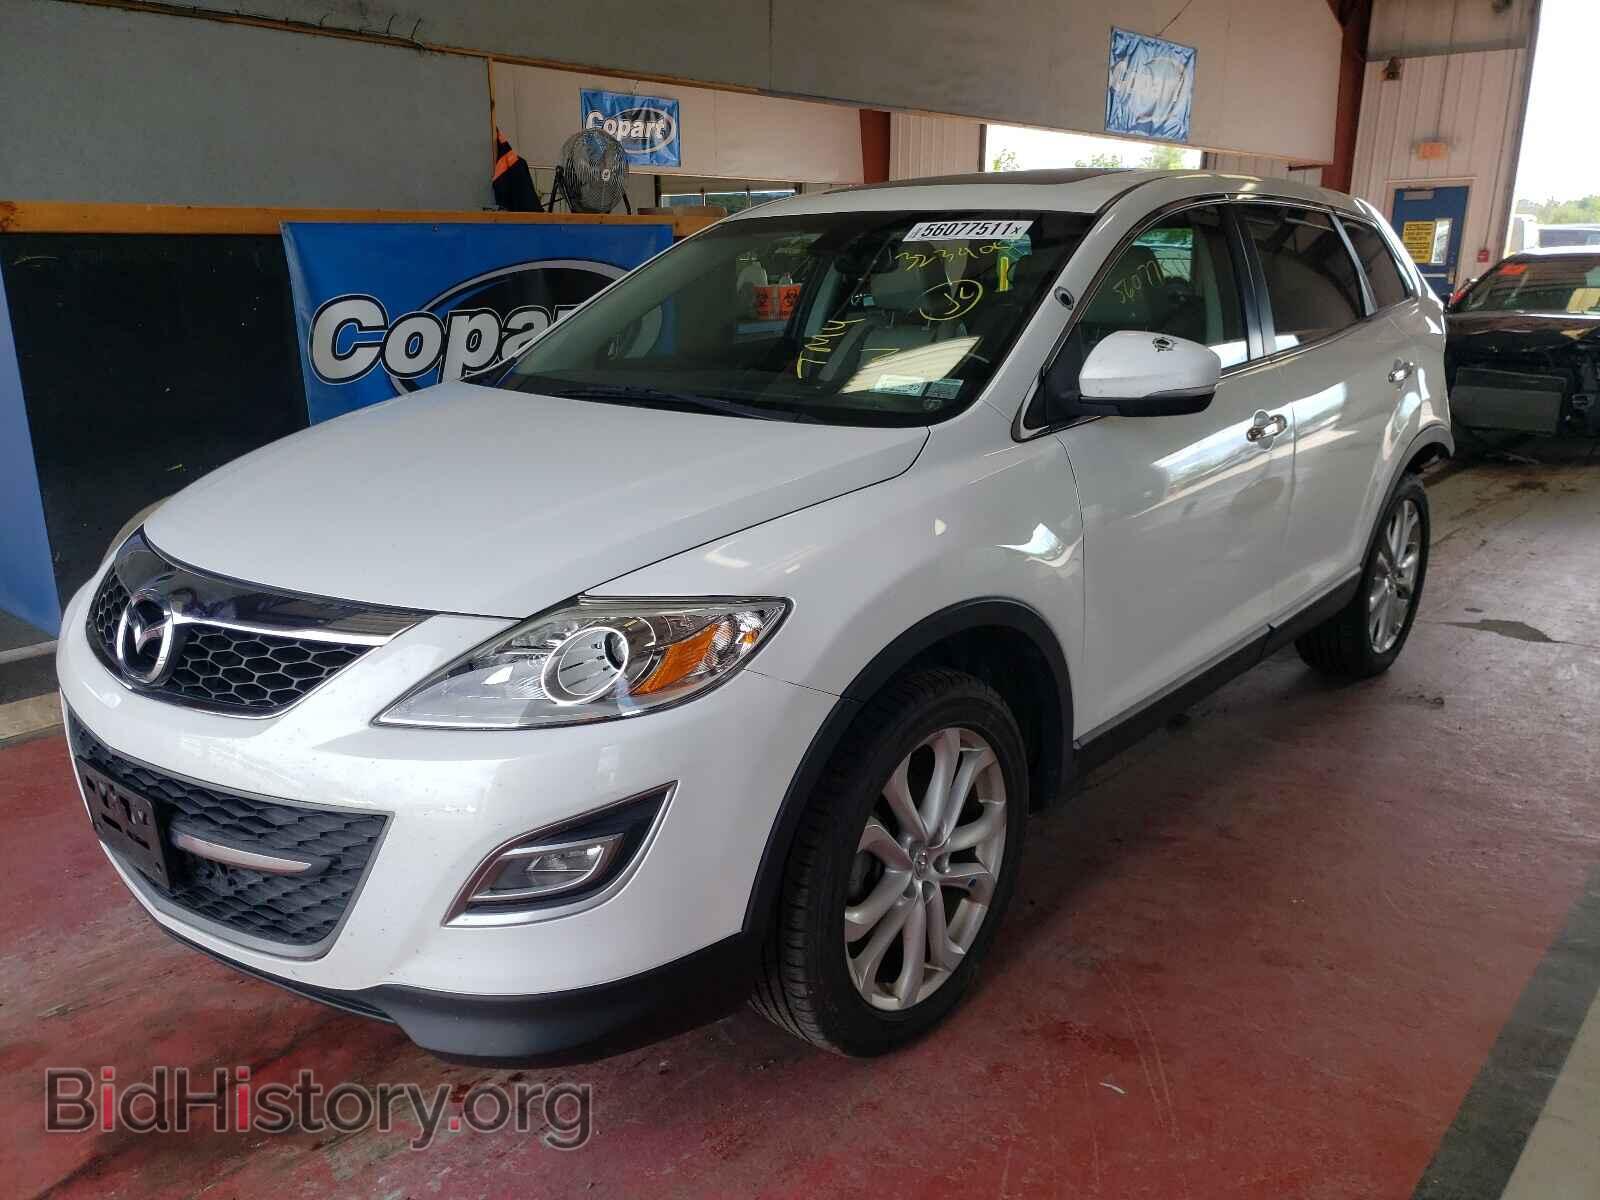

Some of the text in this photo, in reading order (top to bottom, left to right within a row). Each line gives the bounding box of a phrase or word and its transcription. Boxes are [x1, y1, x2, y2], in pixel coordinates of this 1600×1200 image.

[586, 111, 666, 142] Copart
[920, 222, 1014, 238] 56077511
[309, 293, 581, 385] Copa
